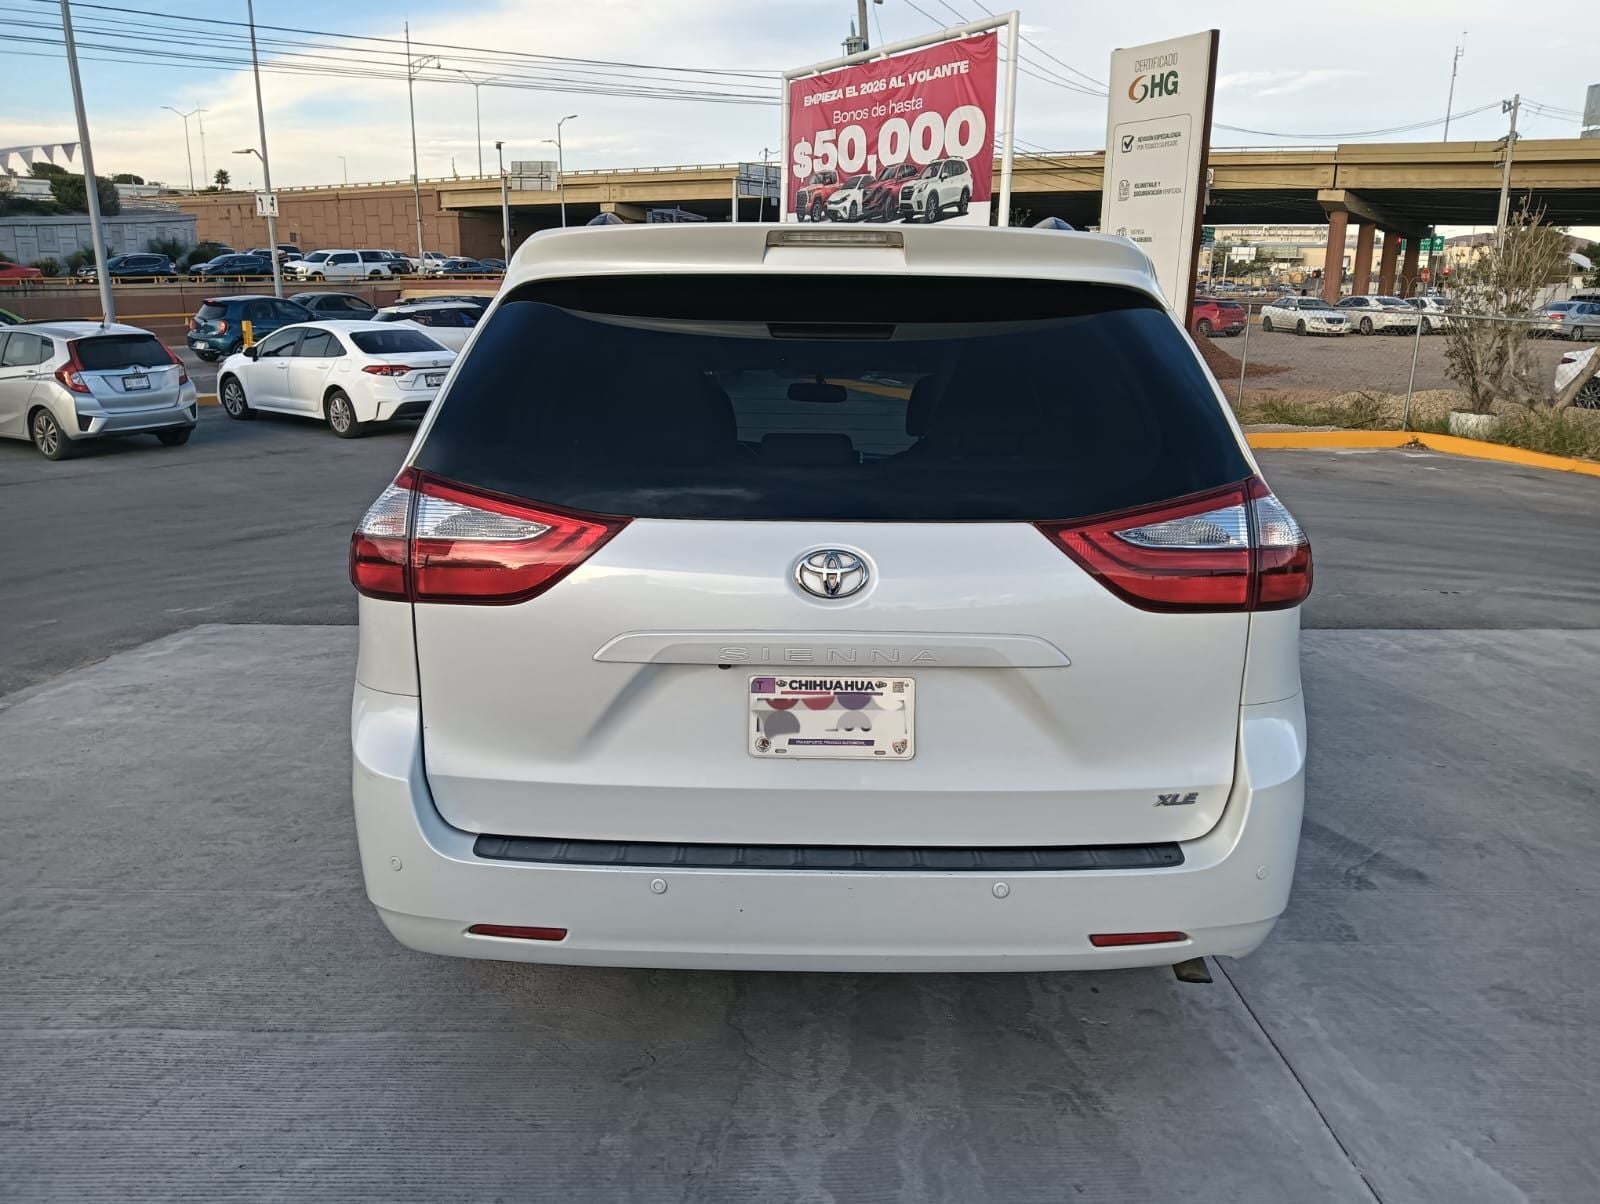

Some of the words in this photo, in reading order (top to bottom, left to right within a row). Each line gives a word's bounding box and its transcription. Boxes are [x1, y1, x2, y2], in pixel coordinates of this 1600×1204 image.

[1134, 52, 1178, 73] CERTIFICADO
[804, 88, 843, 107] EMPIEZA
[845, 84, 858, 98] EL
[860, 79, 886, 95] 2026
[889, 73, 905, 89] AL
[908, 60, 969, 84] VOLANTE
[833, 106, 868, 125] Bonos
[871, 104, 886, 118] de
[888, 96, 923, 114] hasta
[792, 105, 987, 182] $50,000
[719, 647, 942, 663] SIENNA
[756, 680, 764, 691] T
[788, 679, 875, 691] CHIHUAHUA
[1152, 792, 1199, 807] XLE
